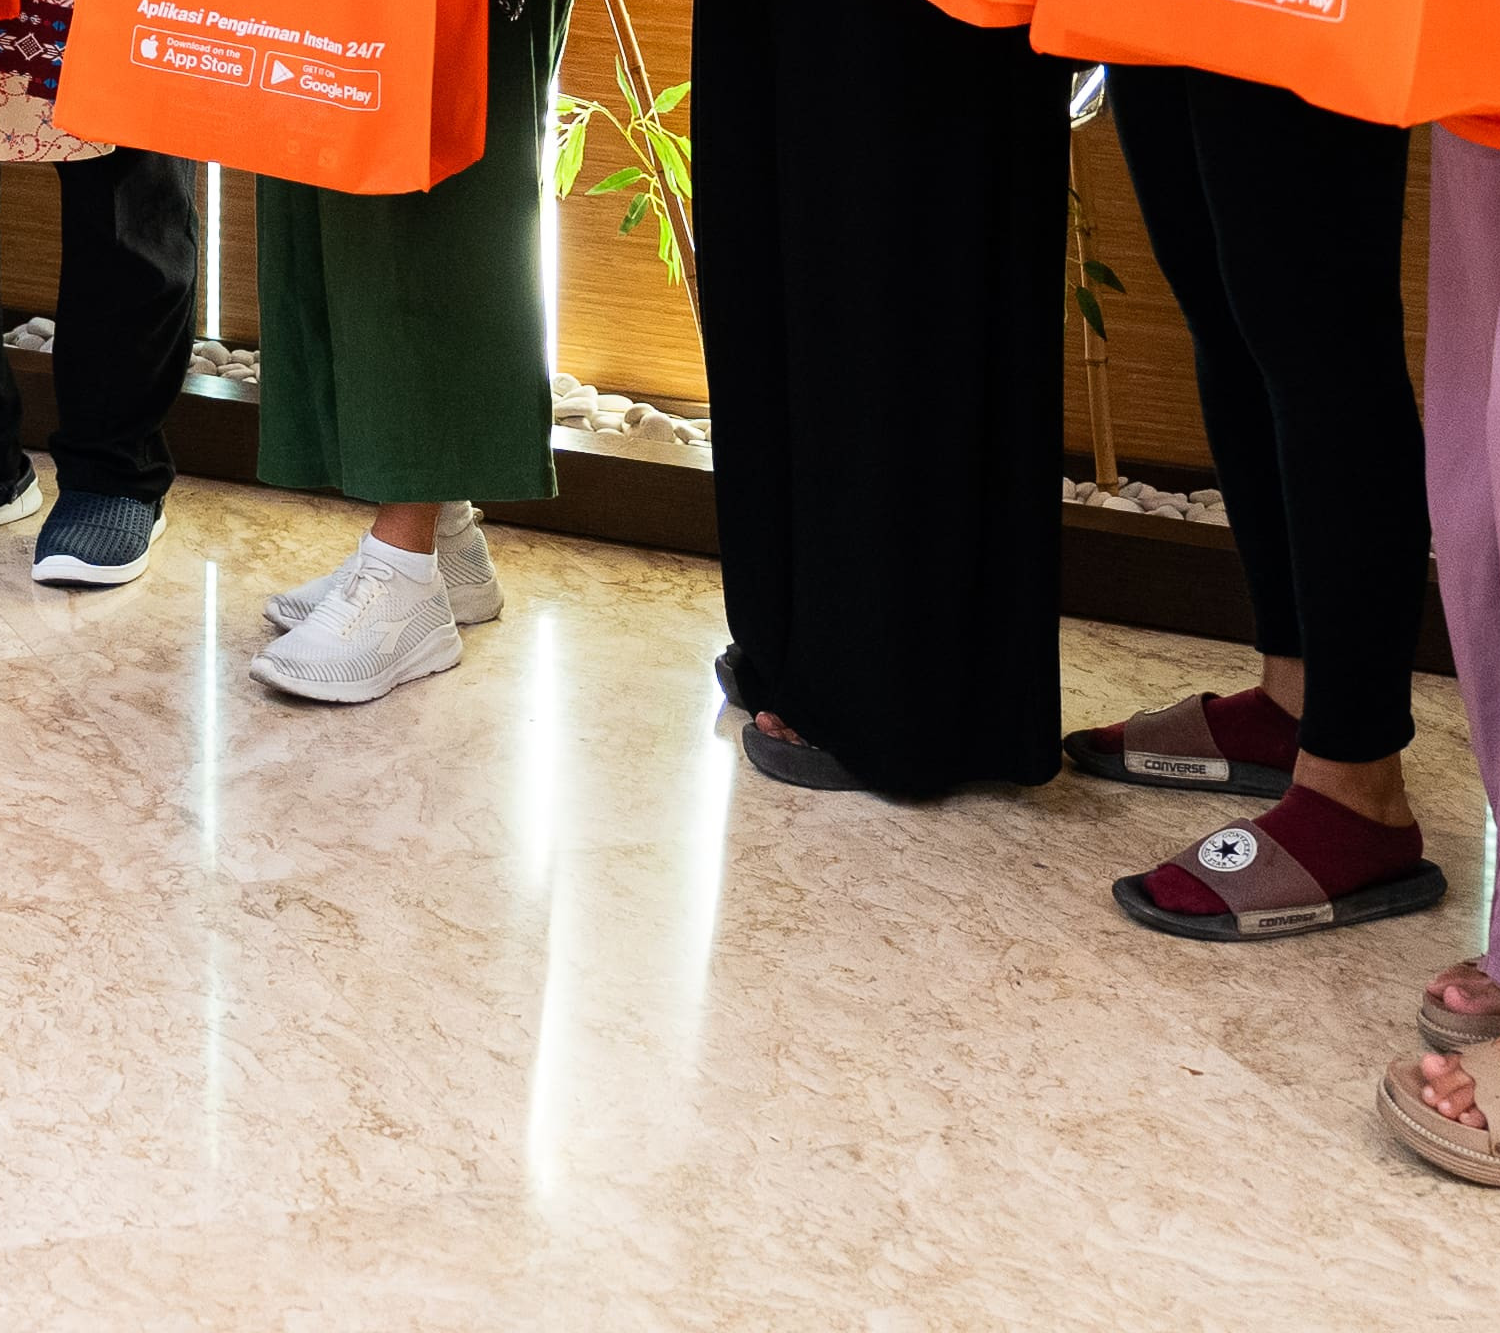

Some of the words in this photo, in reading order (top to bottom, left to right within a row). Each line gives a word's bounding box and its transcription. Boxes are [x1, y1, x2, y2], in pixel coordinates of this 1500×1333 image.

[167, 37, 210, 53] Download
[213, 46, 224, 55] on
[226, 48, 241, 59] the
[206, 11, 300, 44] Pengiriman
[303, 30, 343, 56] Instan
[346, 42, 385, 59] 24/7
[163, 49, 198, 69] App
[200, 55, 243, 77] Store
[300, 75, 342, 98] Google
[344, 86, 372, 105] Play
[1144, 760, 1207, 773] CONVERSE
